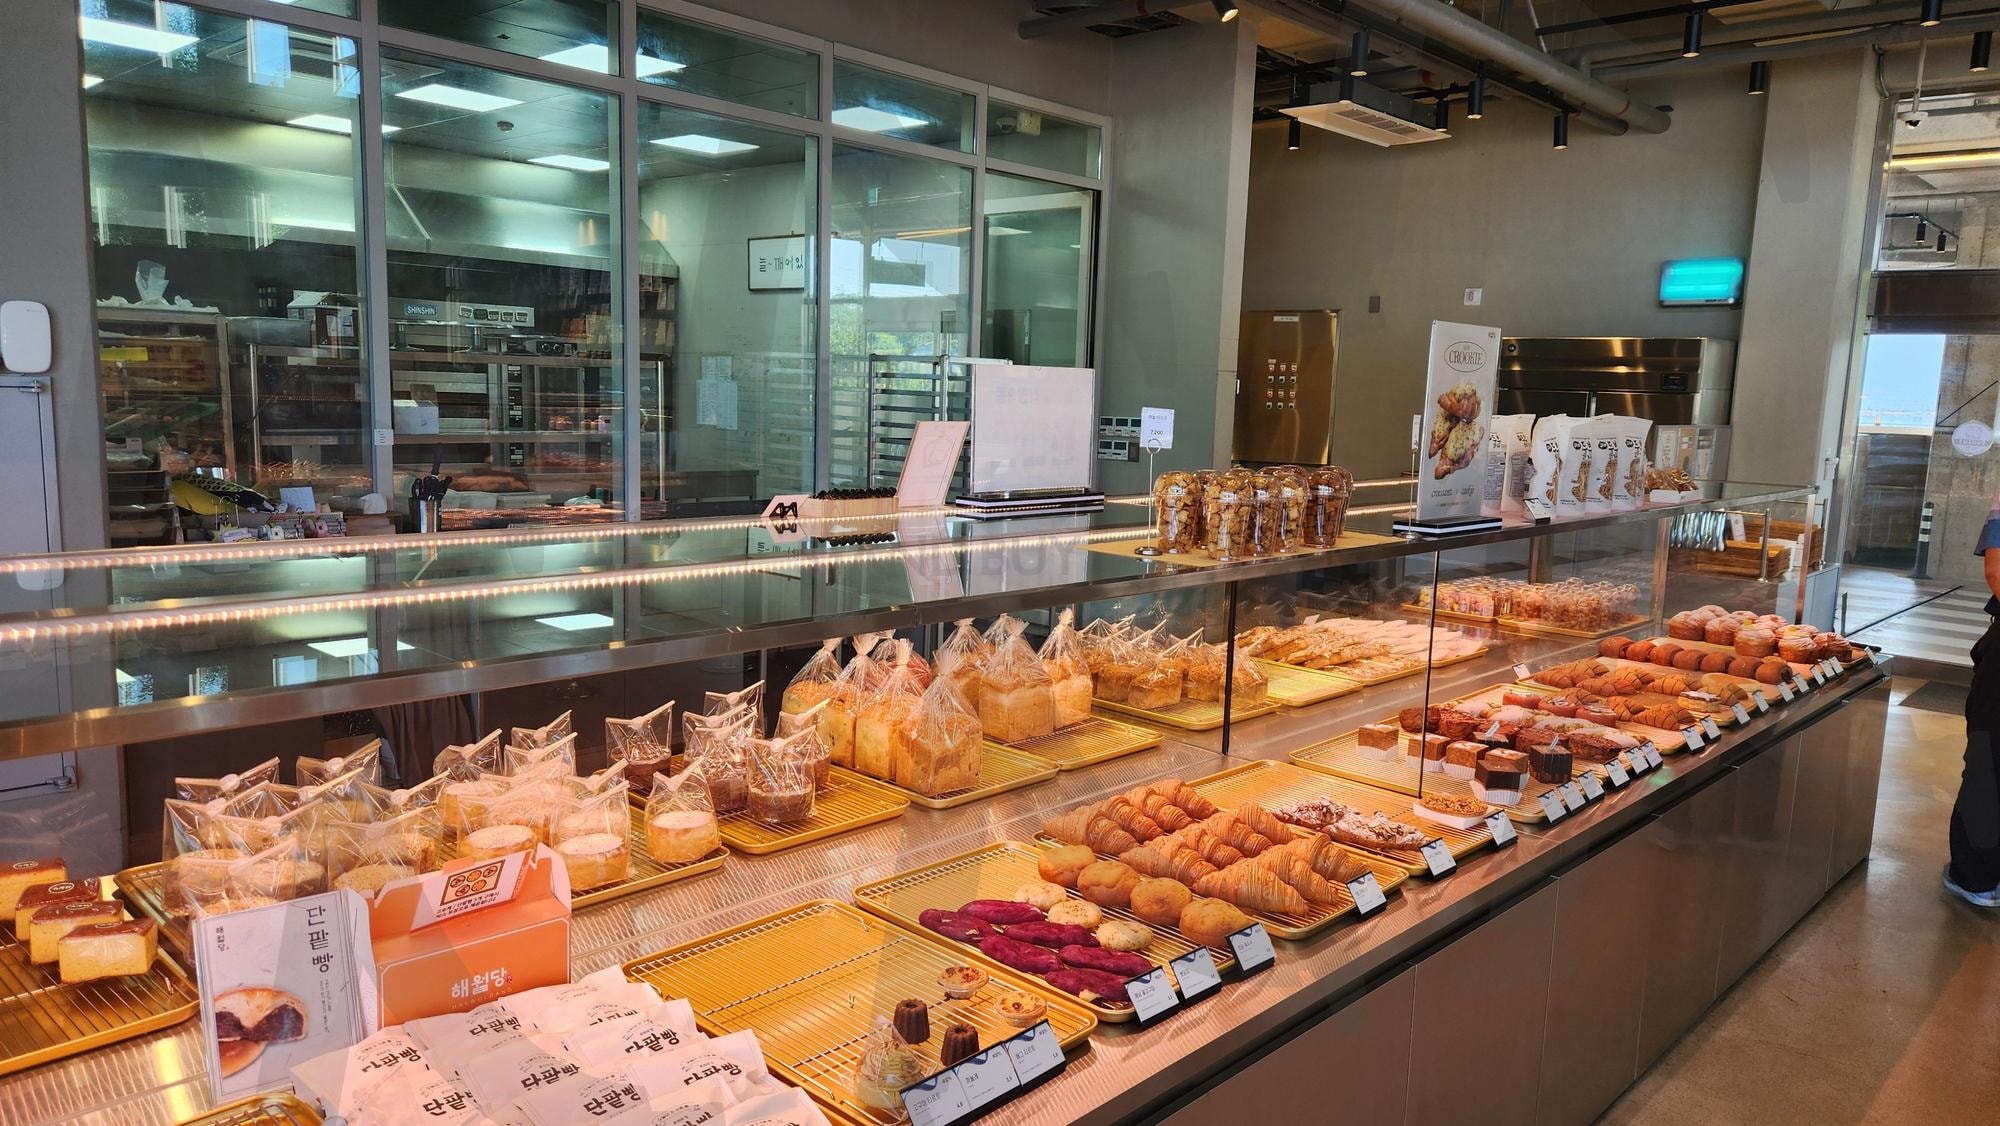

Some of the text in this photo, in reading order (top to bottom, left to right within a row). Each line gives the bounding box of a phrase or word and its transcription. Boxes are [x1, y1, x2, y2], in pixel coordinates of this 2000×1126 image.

[407, 305, 436, 315] SHINSHIN
[1449, 350, 1483, 365] CROOKIE
[305, 904, 334, 973] 단팥빵
[451, 967, 508, 998] 해월당
